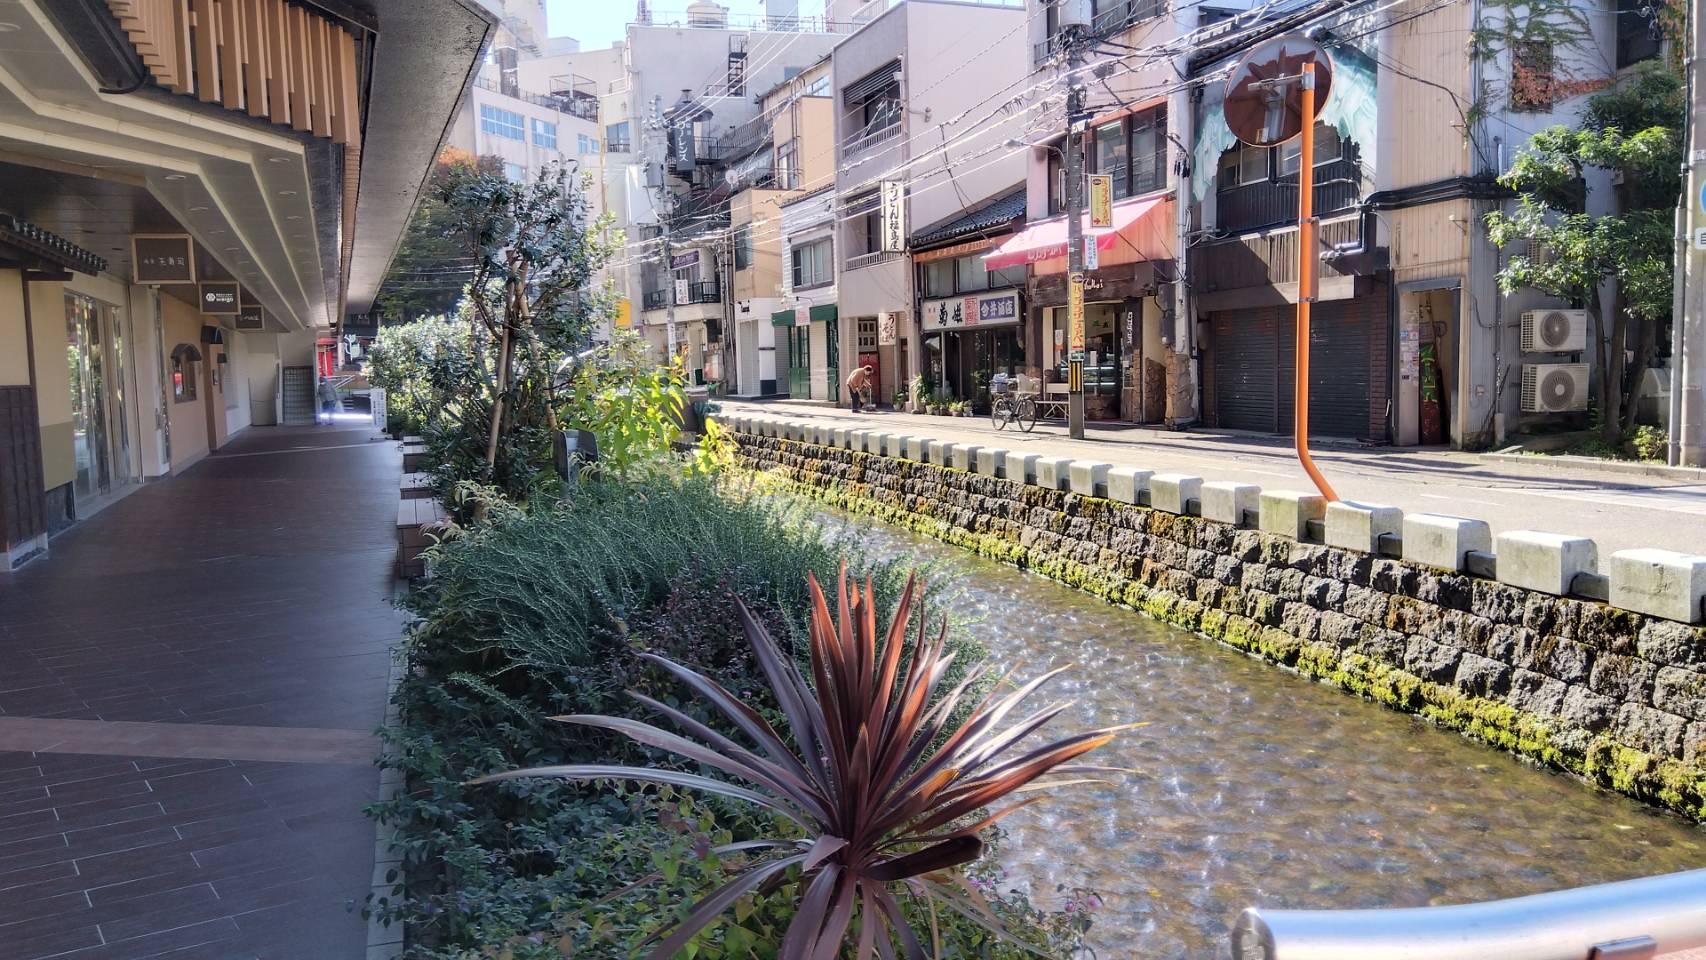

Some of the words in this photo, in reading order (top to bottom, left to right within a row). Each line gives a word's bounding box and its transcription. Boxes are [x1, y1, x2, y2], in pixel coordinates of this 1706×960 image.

[889, 182, 900, 251] うどん福島屋
[981, 300, 1013, 317] 今井酒店
[888, 314, 896, 340] うどん
